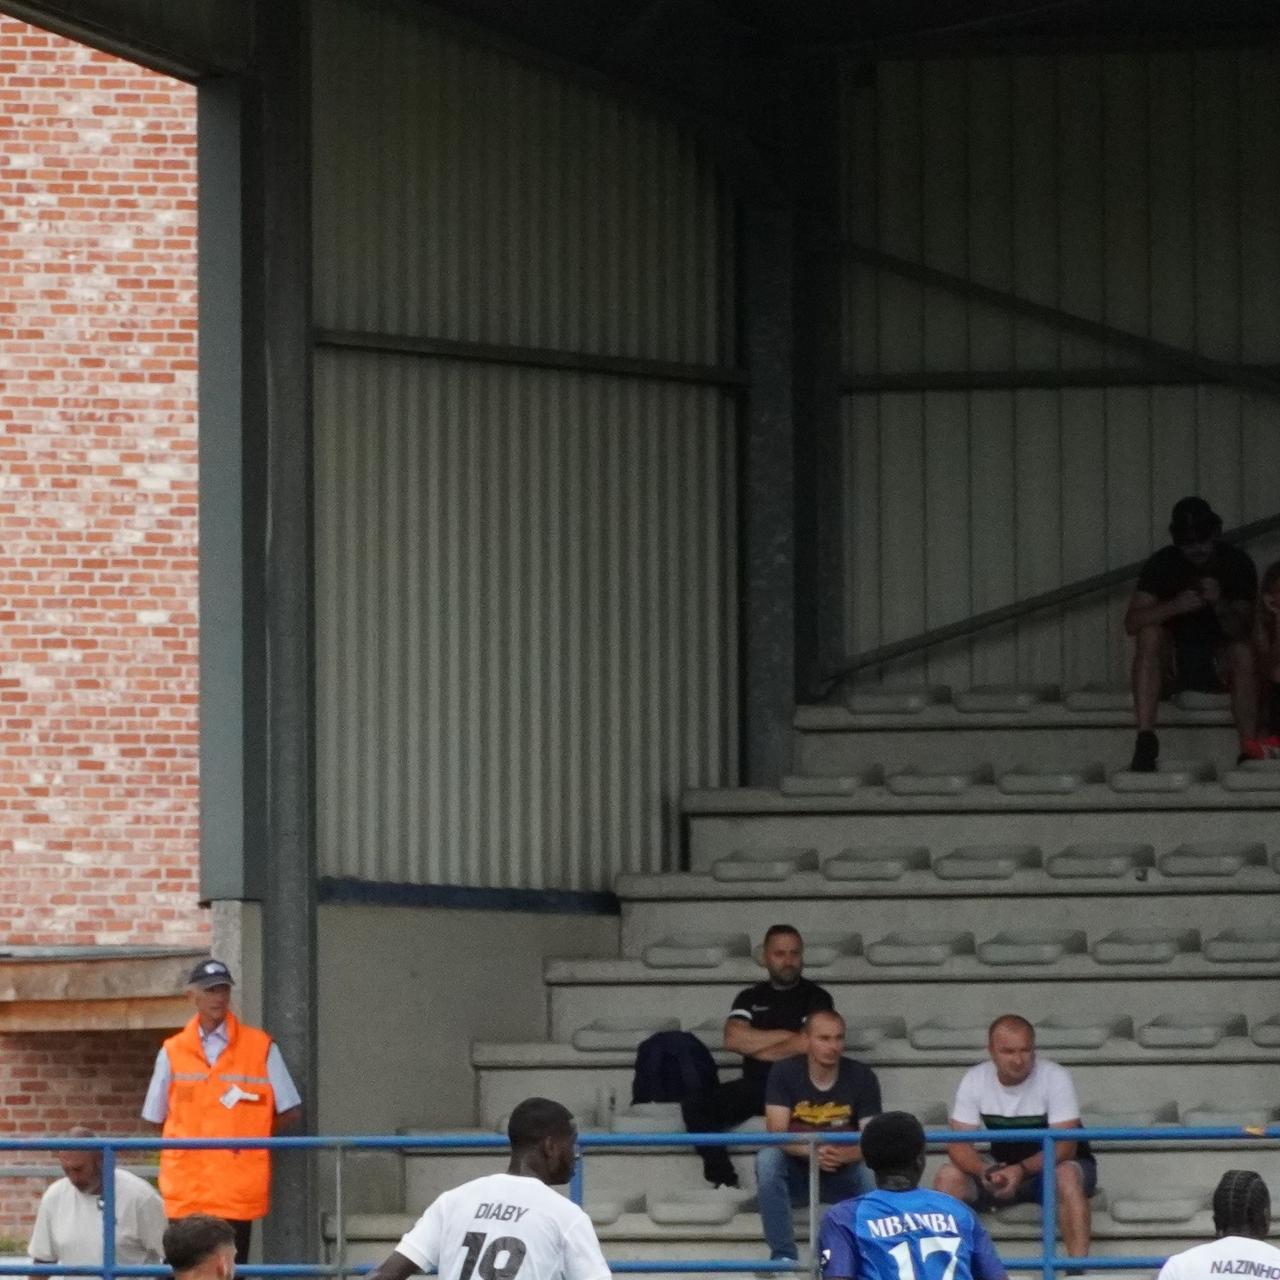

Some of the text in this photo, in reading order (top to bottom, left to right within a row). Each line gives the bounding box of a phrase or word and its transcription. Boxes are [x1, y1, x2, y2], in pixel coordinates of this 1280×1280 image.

[474, 1203, 530, 1222] DIABY
[867, 1213, 959, 1239] MBAMBA
[1210, 1259, 1280, 1280] NAZINHO
